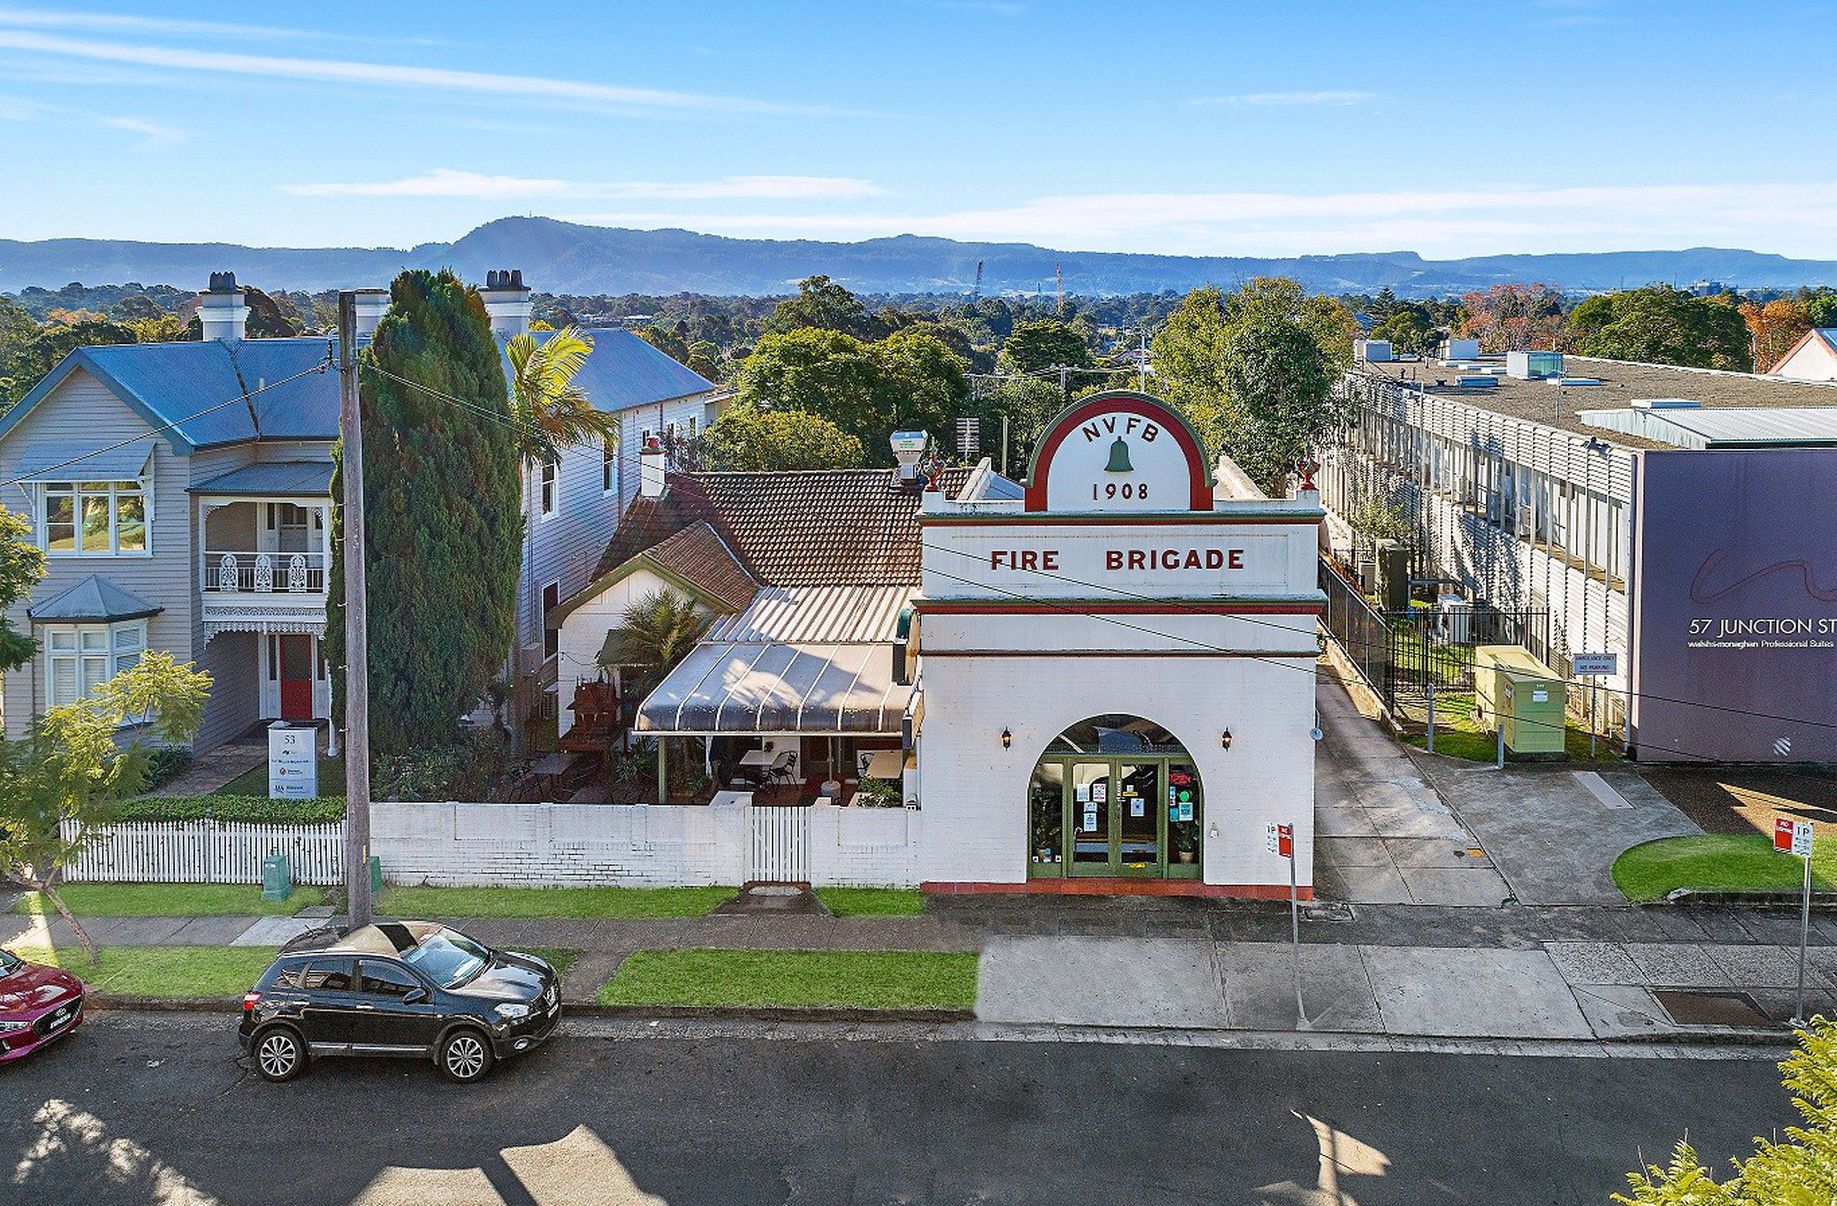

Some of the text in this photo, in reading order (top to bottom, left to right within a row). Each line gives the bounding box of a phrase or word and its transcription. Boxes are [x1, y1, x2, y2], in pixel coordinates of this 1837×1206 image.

[1082, 416, 1159, 443] NVFB
[1093, 483, 1149, 500] 1908
[991, 549, 1244, 571] FIRE BRIGADE
[1689, 619, 1837, 638] 57 JUNCTION ST
[284, 735, 296, 744] 53
